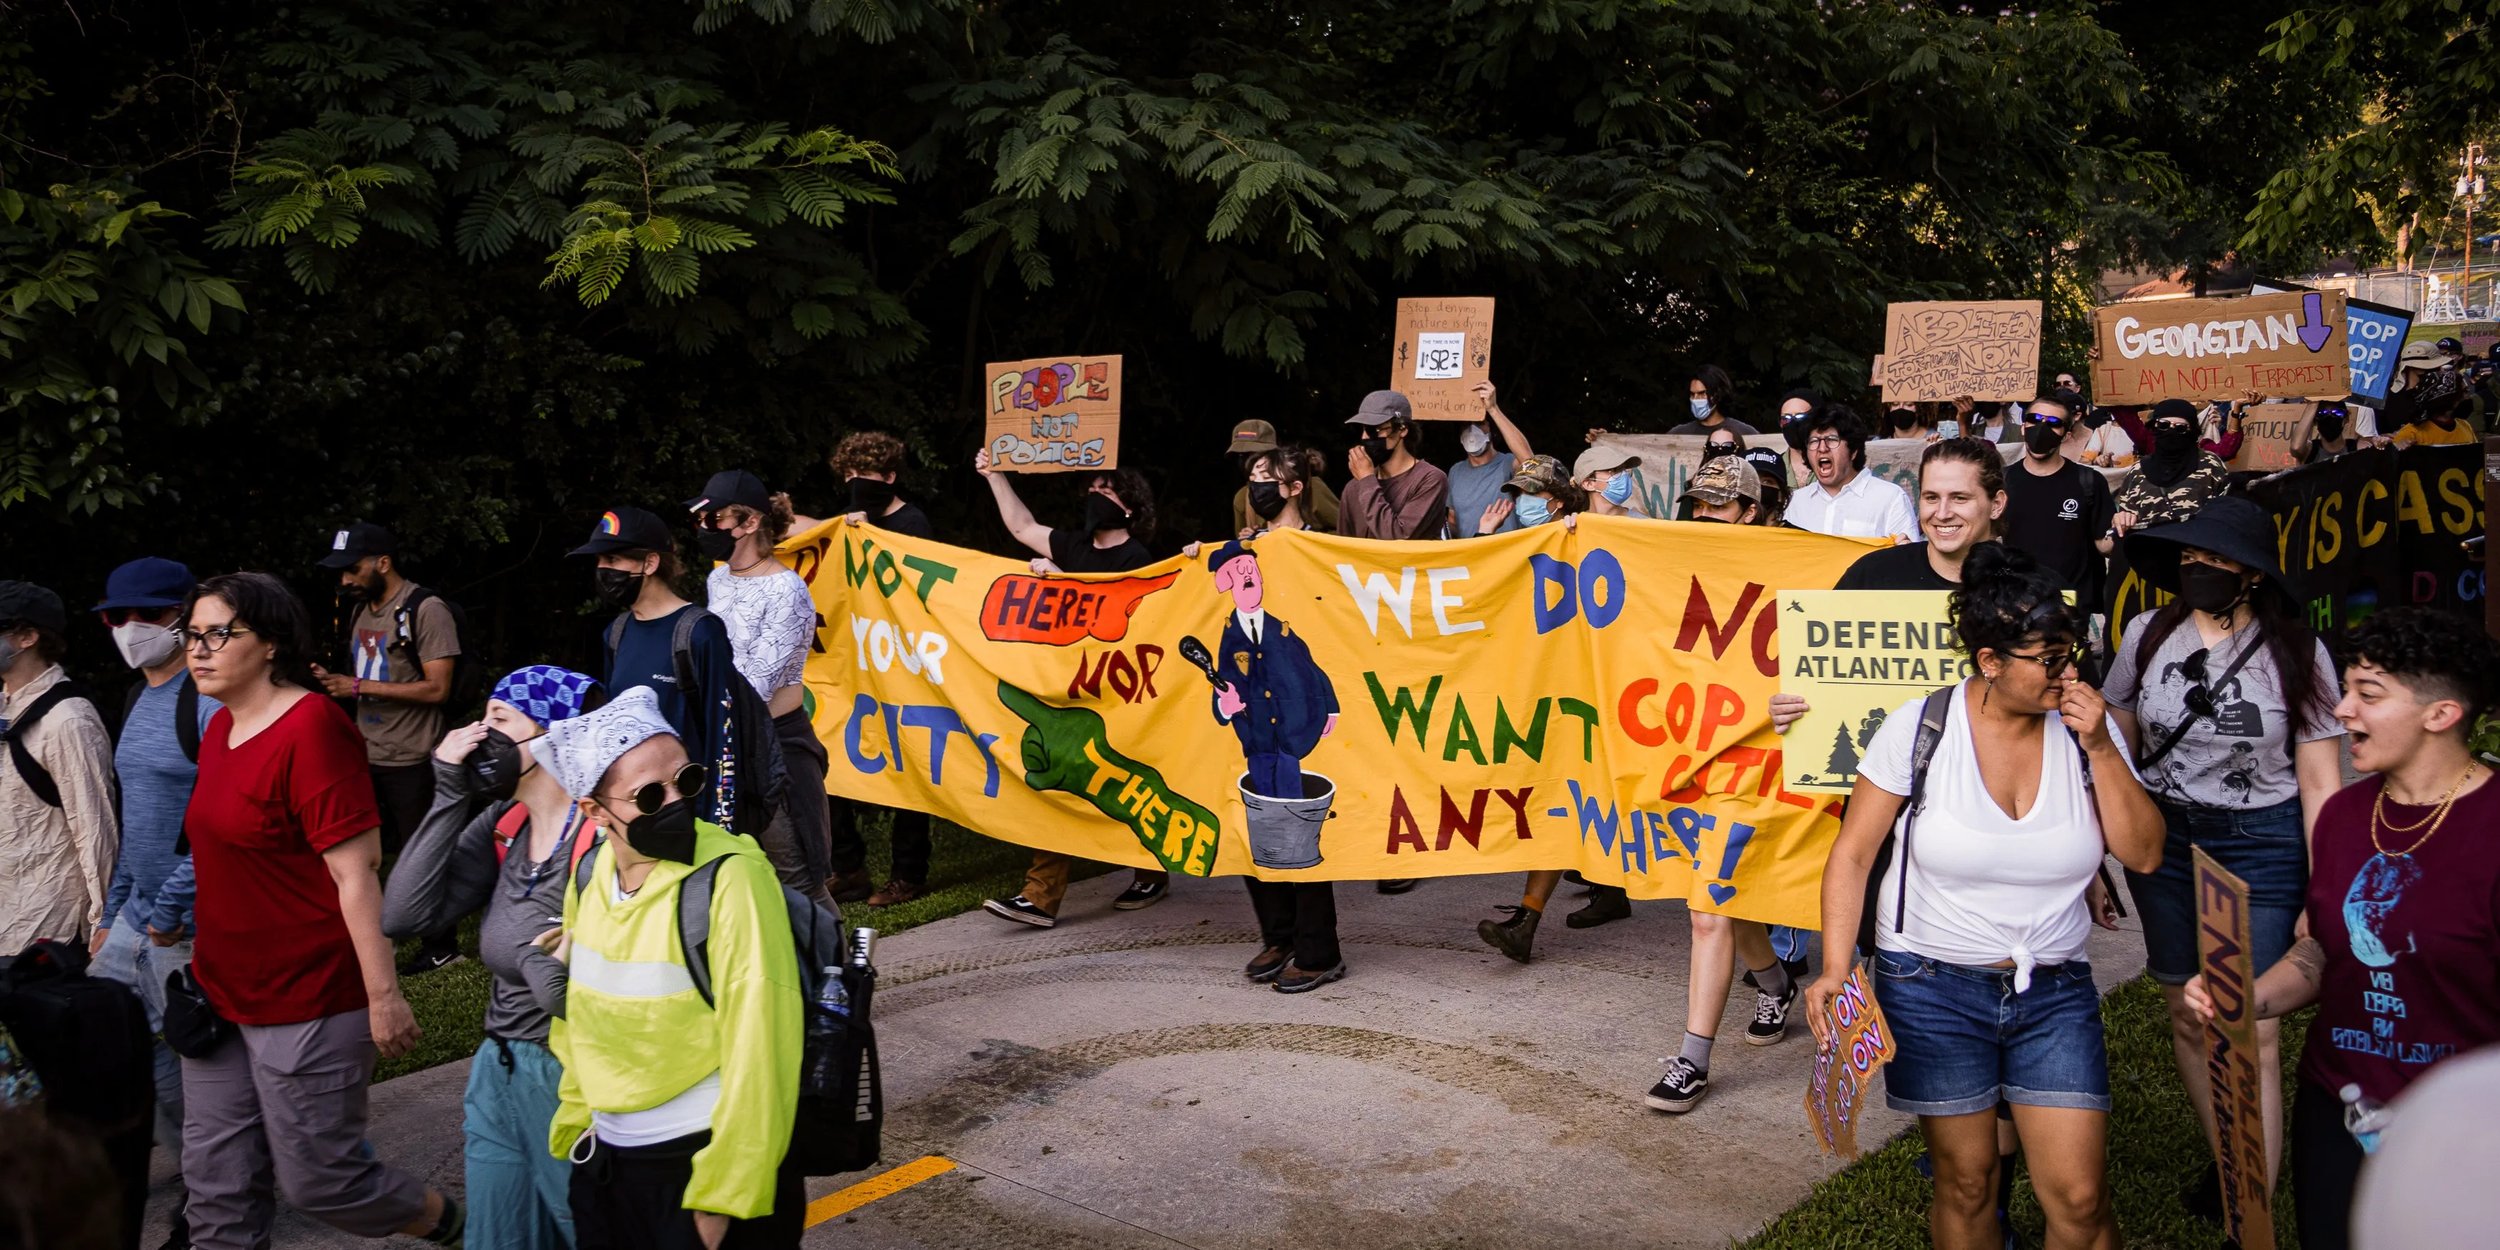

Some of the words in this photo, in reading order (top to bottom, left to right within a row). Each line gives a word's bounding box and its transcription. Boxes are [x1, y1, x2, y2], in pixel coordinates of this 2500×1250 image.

[1406, 301, 1430, 316] Stop
[1437, 301, 1476, 318] denying
[1410, 317, 1448, 329] nature
[1463, 316, 1488, 333] dying
[1894, 308, 2040, 356] ABOLITION
[2347, 316, 2398, 343] TOP
[1957, 340, 2035, 375] NOW
[2114, 312, 2299, 360] GEORGIAN
[2348, 343, 2383, 364] OP
[992, 362, 1109, 415] PEOPLE
[2101, 368, 2124, 396] I
[2138, 368, 2166, 393] AM
[2178, 366, 2223, 392] NOT
[2245, 363, 2335, 389] TERRORIST
[2349, 367, 2379, 390] TY
[1031, 412, 1079, 439] NOT
[1417, 400, 1450, 412] world
[1454, 403, 1466, 413] on
[991, 433, 1106, 467] POLICE
[844, 533, 958, 614] NOT
[1336, 564, 1485, 639] WE
[1528, 548, 1625, 635] DO
[998, 580, 1107, 628] HERE!
[850, 612, 948, 684] YOUR
[1795, 655, 1931, 681] ATLANTA
[1067, 643, 1164, 704] NOR
[1362, 671, 1599, 766] WANT
[1617, 677, 1745, 752] COP
[844, 693, 1000, 798] CITY
[1083, 738, 1217, 876] THERE
[2201, 866, 2245, 1023] END
[1834, 971, 1868, 1029] NO
[1851, 1021, 1884, 1073] NO
[2234, 1050, 2268, 1214] POLICE
